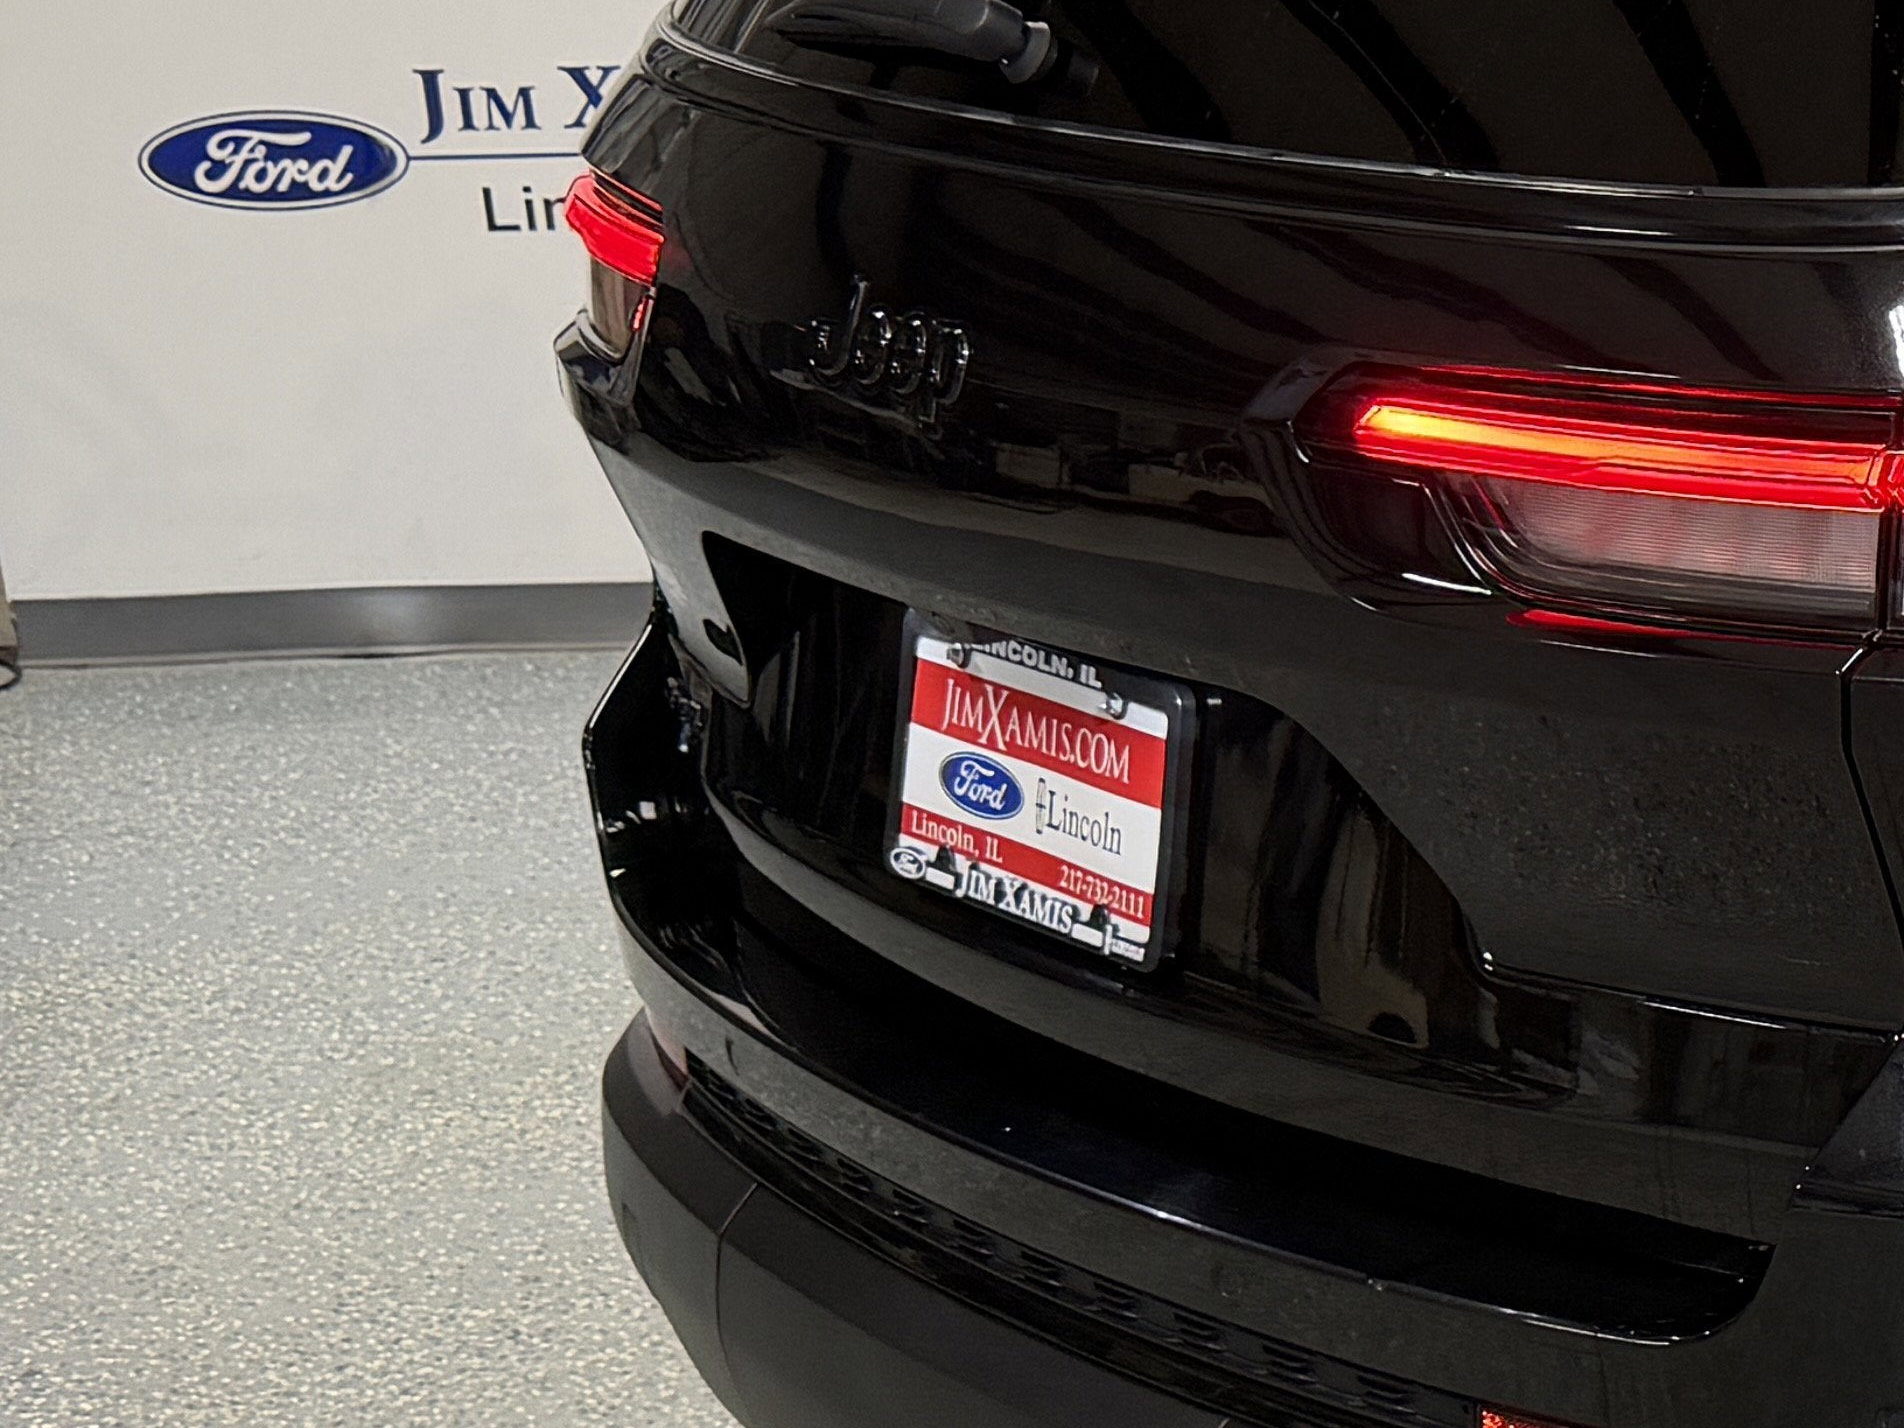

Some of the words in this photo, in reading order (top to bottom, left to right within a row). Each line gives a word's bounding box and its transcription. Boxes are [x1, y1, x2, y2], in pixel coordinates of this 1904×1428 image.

[412, 69, 542, 145] JIM
[194, 129, 354, 193] Ford
[803, 274, 970, 425] Jeep
[941, 678, 1131, 784] JIMXAMIS.COM
[953, 759, 1006, 812] Ford
[911, 810, 979, 857] Lincoln,
[985, 836, 1003, 863] IL
[1046, 789, 1122, 856] Lincoln
[1000, 881, 1074, 935] XAMIS
[1060, 865, 1146, 919] 217-732-2111
